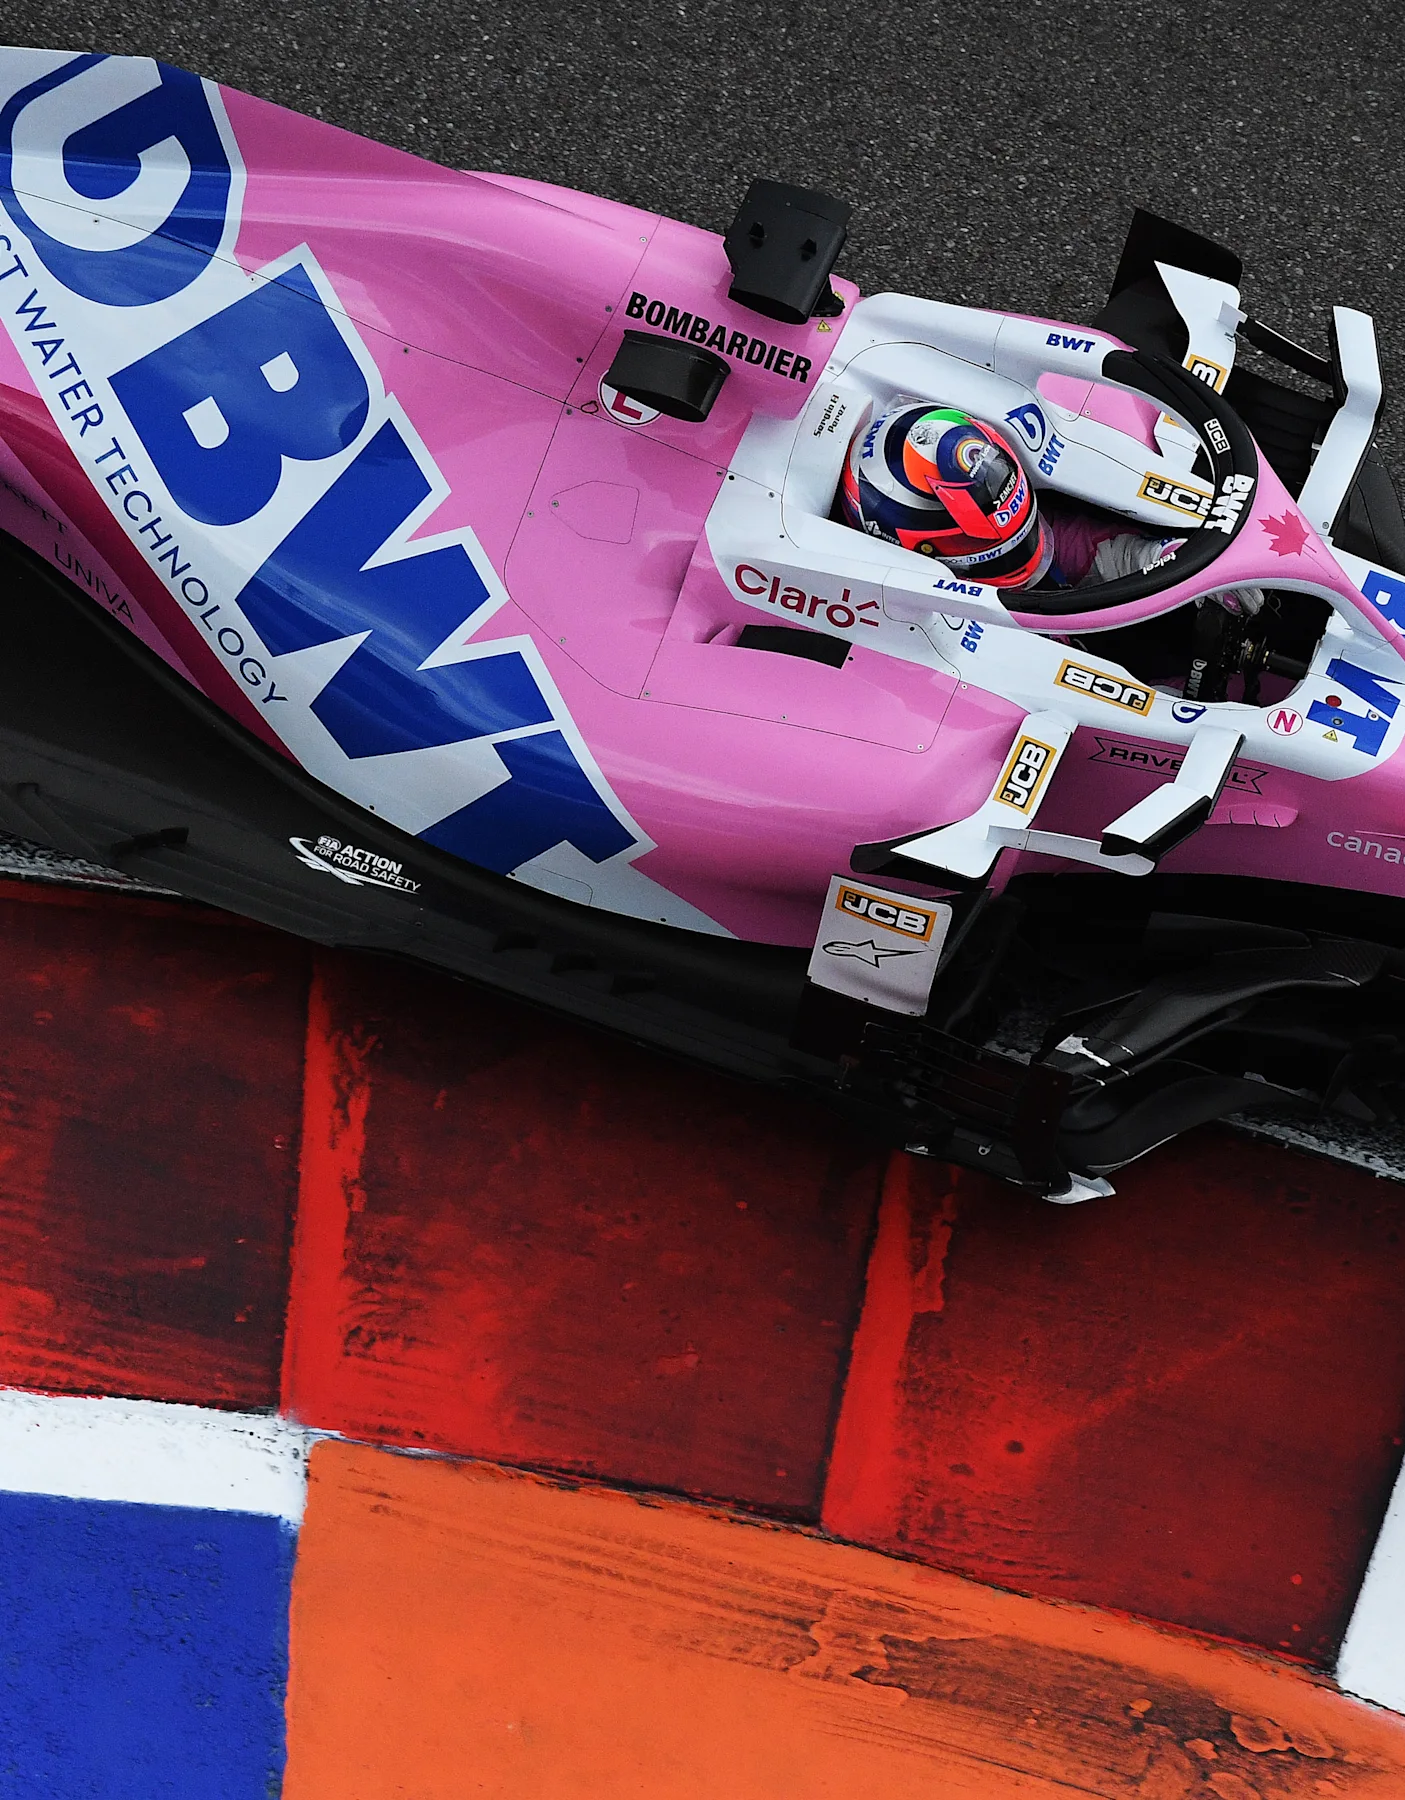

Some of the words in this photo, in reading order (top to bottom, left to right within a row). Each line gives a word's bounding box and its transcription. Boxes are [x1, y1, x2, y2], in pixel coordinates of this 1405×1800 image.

[624, 291, 813, 383] BOMBARDIER
[1045, 333, 1096, 353] BWT
[1038, 433, 1066, 477] BWT
[1207, 420, 1229, 453] JCB
[15, 287, 104, 437] WATER
[94, 439, 289, 706] TECHNOLOGY
[107, 262, 639, 875] BWT
[978, 548, 1004, 563] BWT
[1142, 551, 1177, 576] telcel
[733, 563, 857, 629] Claro
[932, 579, 984, 597] BWT
[960, 620, 984, 653] BW
[1064, 667, 1147, 704] JCB
[1274, 712, 1297, 733] N
[1006, 743, 1047, 806] JCB
[1109, 747, 1248, 785] RAVEL
[313, 845, 333, 858] FOR
[333, 853, 370, 873] ROAD
[370, 866, 422, 892] SAFETY
[318, 836, 339, 850] FIA
[341, 845, 403, 875] ACTION
[843, 896, 927, 934] JCB
